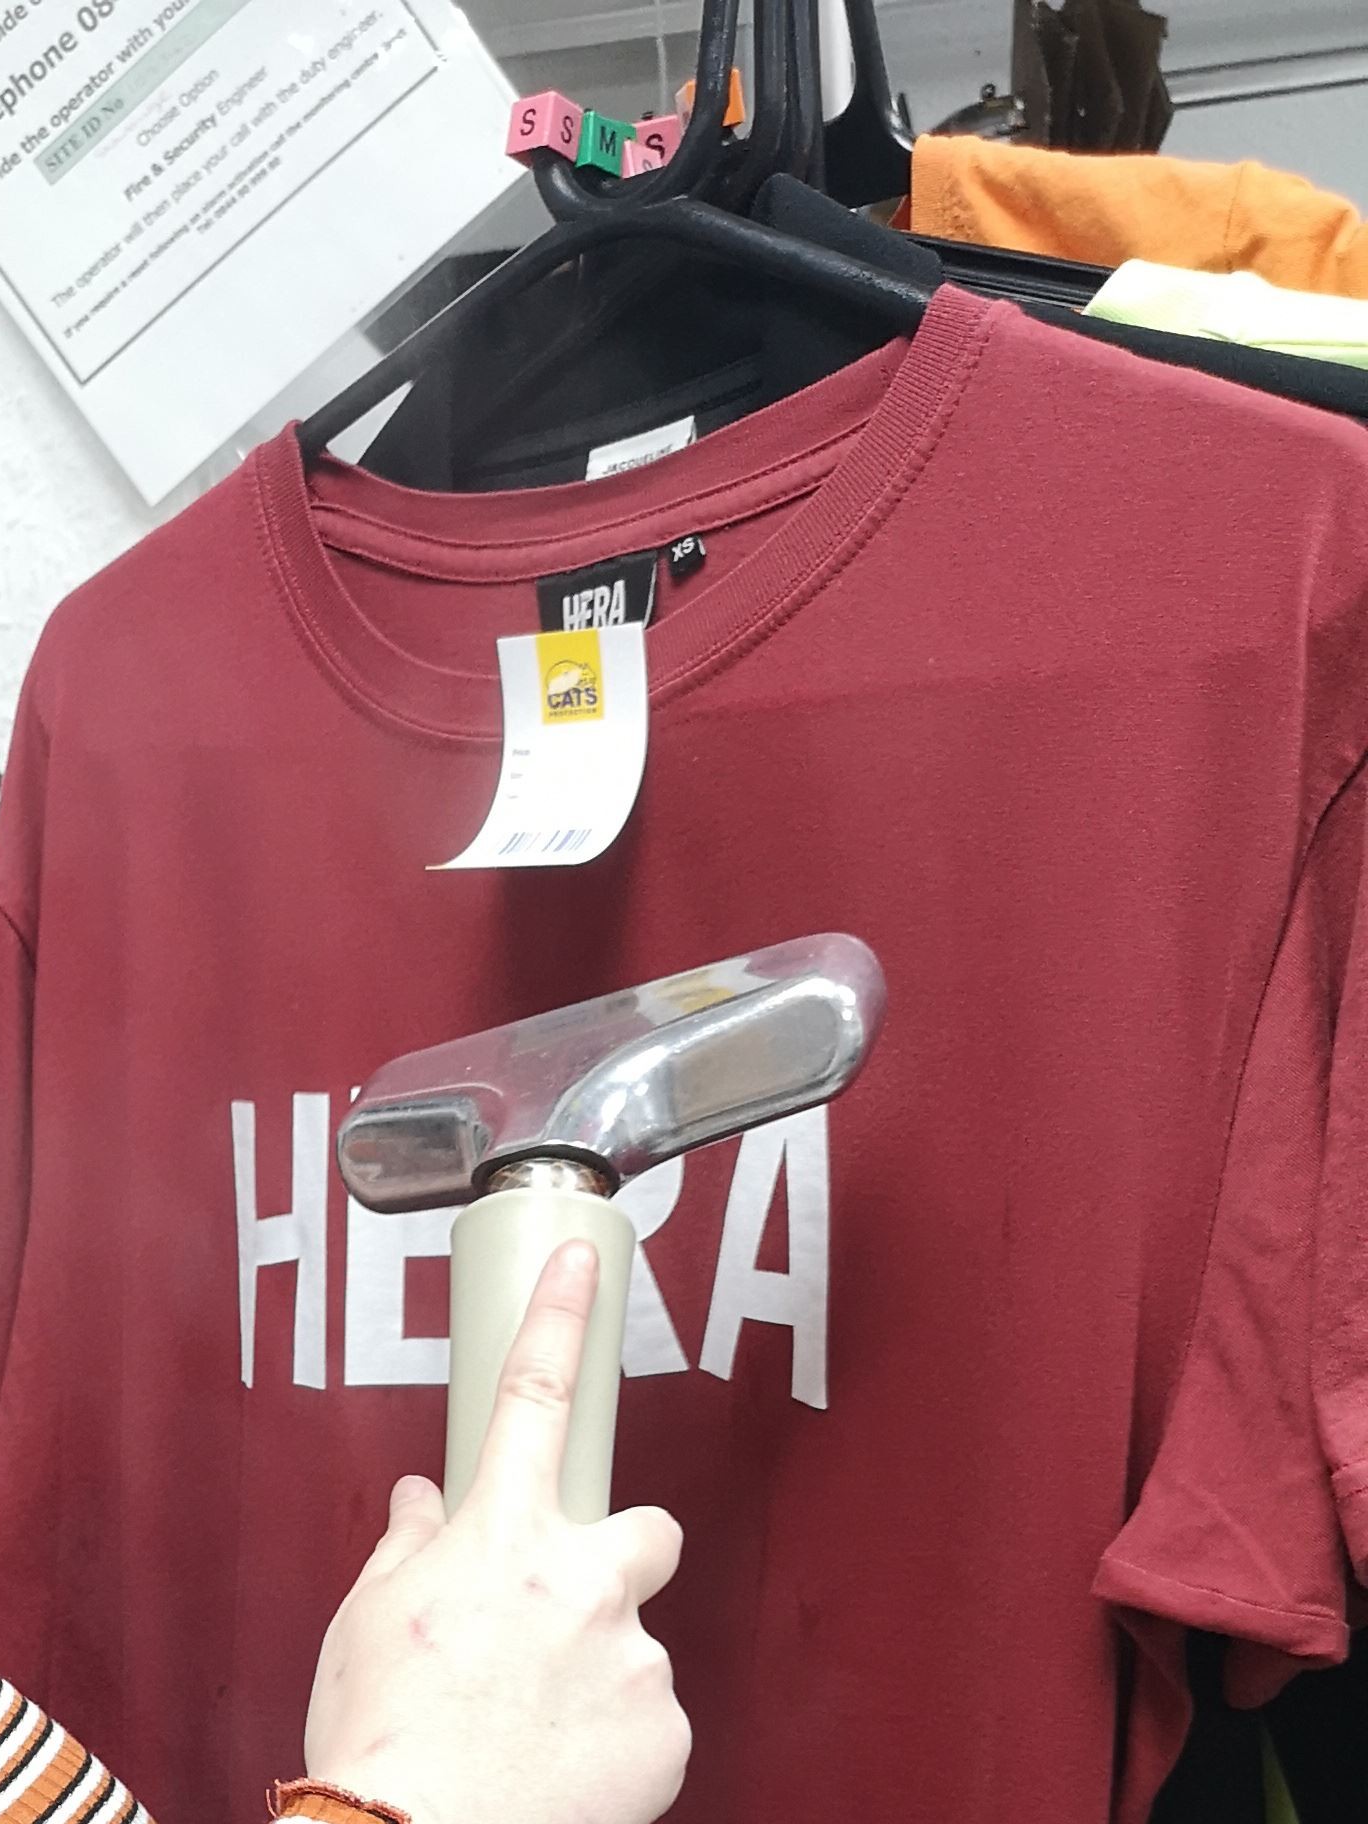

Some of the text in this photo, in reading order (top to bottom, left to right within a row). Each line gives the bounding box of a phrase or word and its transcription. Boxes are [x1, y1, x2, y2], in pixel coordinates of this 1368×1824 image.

[19, 125, 51, 155] the
[49, 60, 128, 137] operator
[115, 26, 155, 64] with
[135, 105, 182, 148] Choose
[177, 69, 220, 108] Option
[123, 174, 152, 203] Fire
[150, 162, 166, 177] &
[162, 112, 218, 167] Security
[215, 65, 268, 117] Engineer
[520, 109, 537, 136] S
[560, 115, 574, 144] S
[599, 126, 617, 156] M
[44, 133, 84, 174] SITE
[80, 116, 103, 139] ID
[49, 285, 77, 308] The
[75, 242, 123, 289] operator
[122, 220, 146, 245] will
[141, 198, 171, 227] then
[169, 169, 204, 205] place
[200, 144, 229, 175] your
[229, 122, 252, 148] call
[250, 101, 278, 128] with
[274, 81, 300, 104] the
[298, 56, 327, 85] duty
[326, 9, 384, 61] engineer.
[646, 133, 665, 159] S
[671, 537, 695, 562] XS
[562, 579, 626, 631] HERA
[547, 686, 598, 709] CATS
